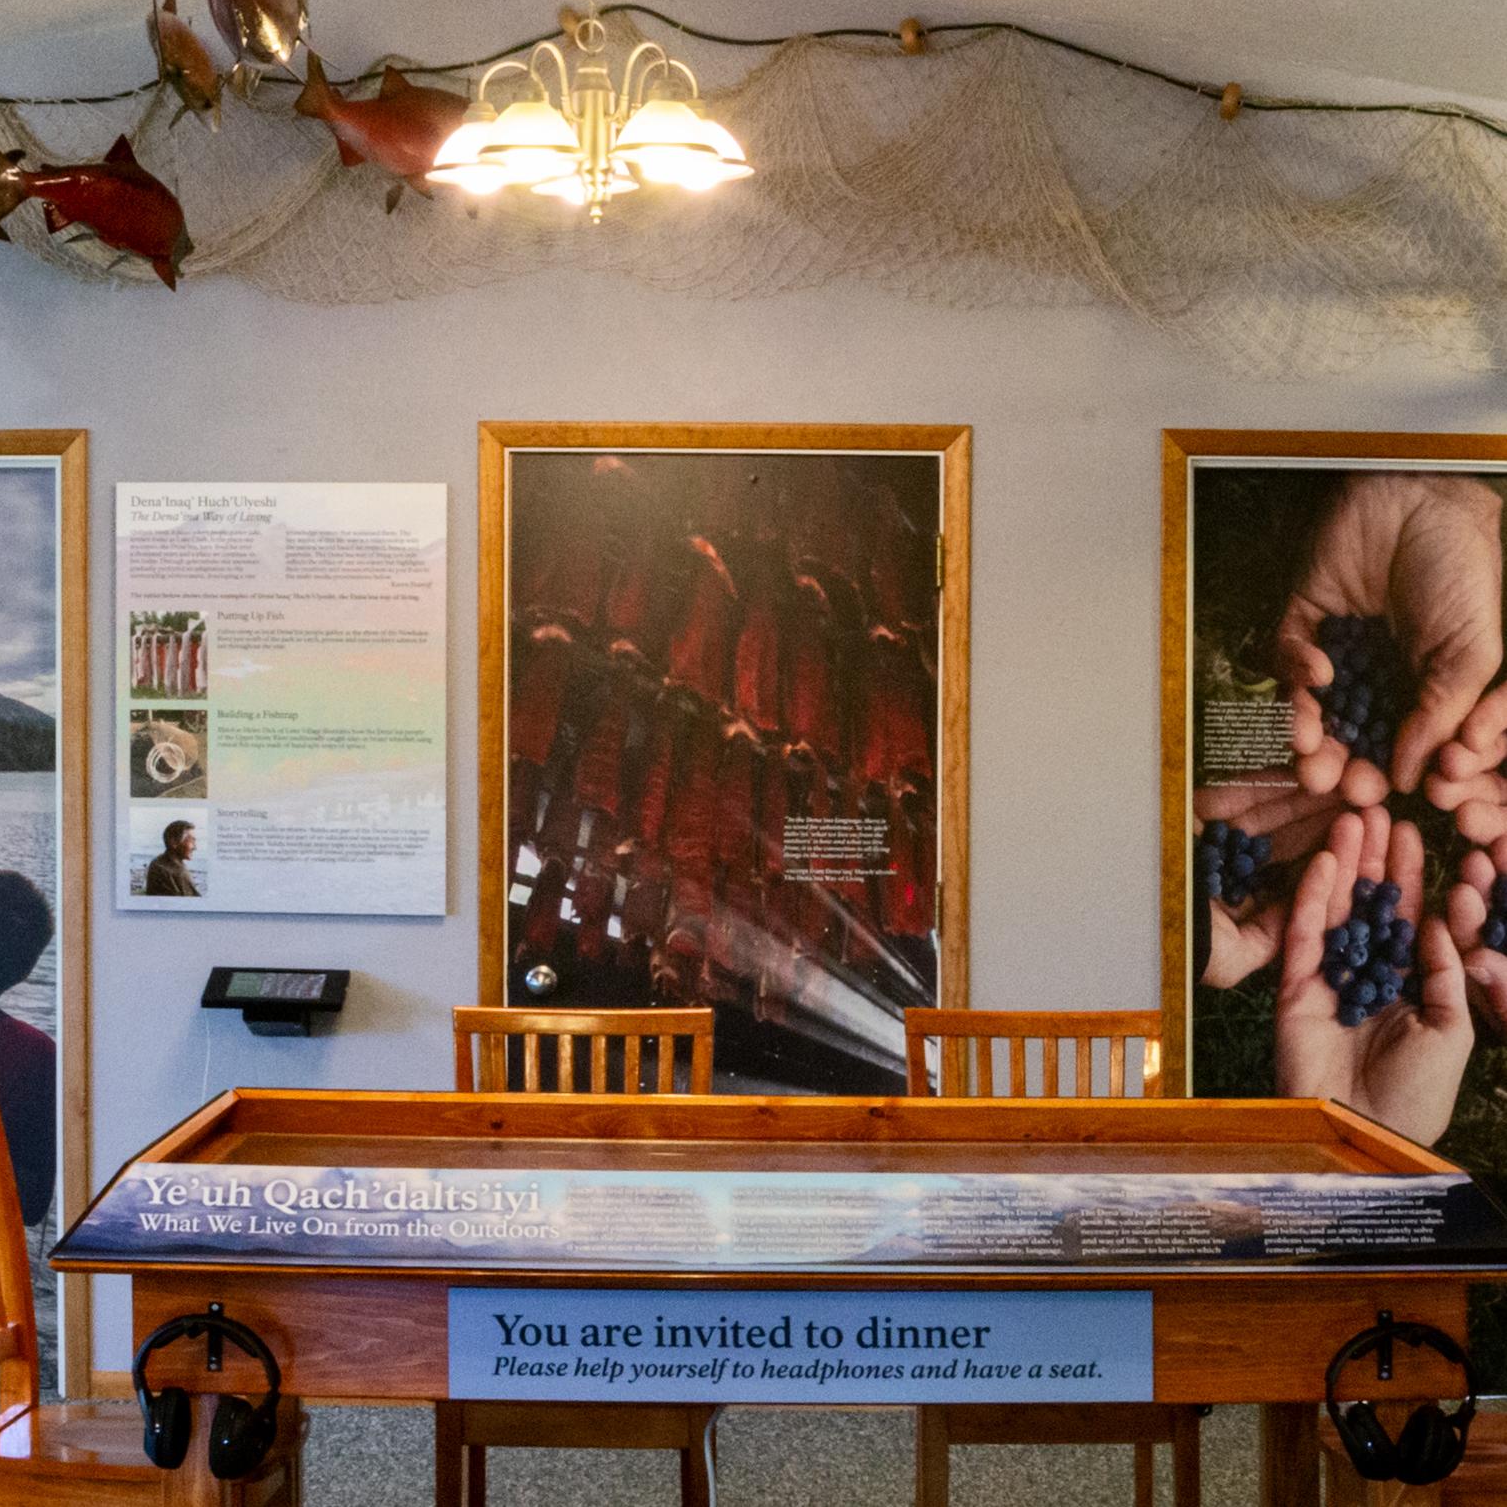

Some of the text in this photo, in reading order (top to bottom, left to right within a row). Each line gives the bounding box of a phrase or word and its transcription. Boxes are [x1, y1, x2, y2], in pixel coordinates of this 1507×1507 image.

[131, 511, 149, 521] The
[203, 511, 224, 523] Way
[227, 511, 238, 524] of
[240, 512, 273, 525] Living
[251, 611, 265, 622] Up
[267, 611, 285, 620] Fish
[145, 1177, 252, 1207] Ye'uh
[263, 1179, 542, 1220] Qach'dalts'iyi
[139, 1212, 561, 1240] What We Live On from the Outdoors
[494, 1314, 991, 1350] You are invited to dinner
[494, 1357, 1103, 1385] Please help yourself to headphones and have a seat.
